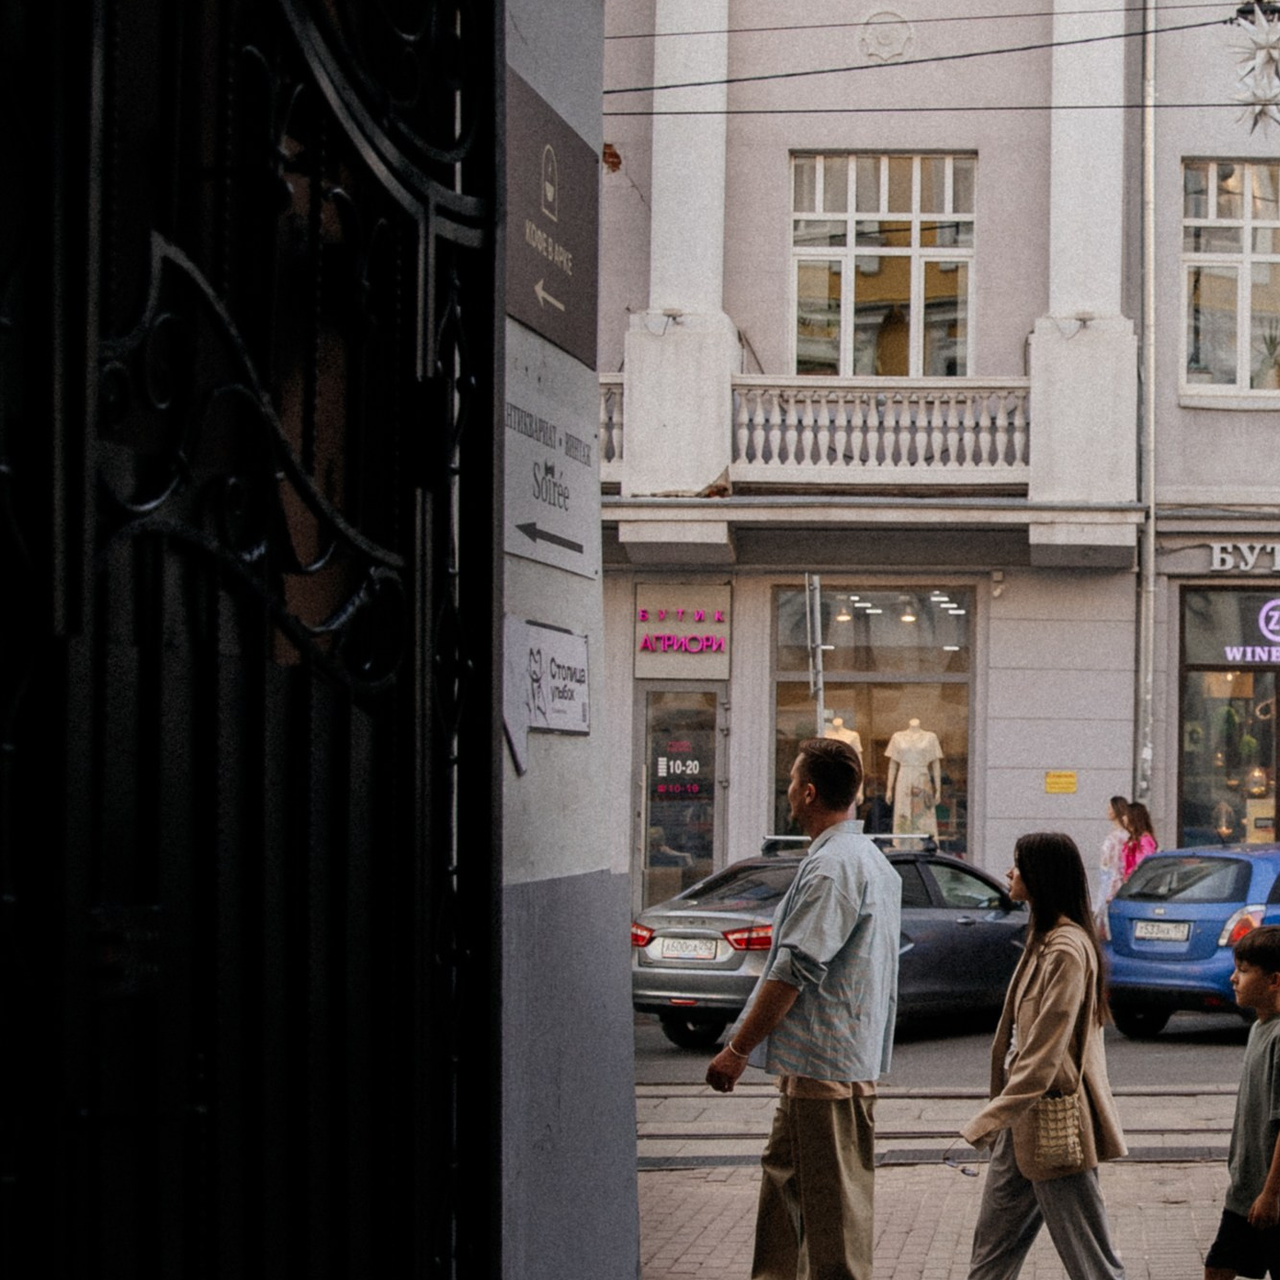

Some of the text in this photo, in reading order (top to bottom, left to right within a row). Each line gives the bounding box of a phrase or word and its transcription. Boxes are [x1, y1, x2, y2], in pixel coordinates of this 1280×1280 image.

[526, 219, 547, 256] КОФЕ
[554, 243, 572, 275] АРКЕ
[505, 402, 557, 449] НТИКВАРИАТ
[639, 609, 725, 623] БУТИК
[640, 634, 725, 653] АПРИОРИ
[549, 657, 586, 686] Столица
[550, 684, 575, 703] улыбок
[669, 760, 699, 774] 10-20
